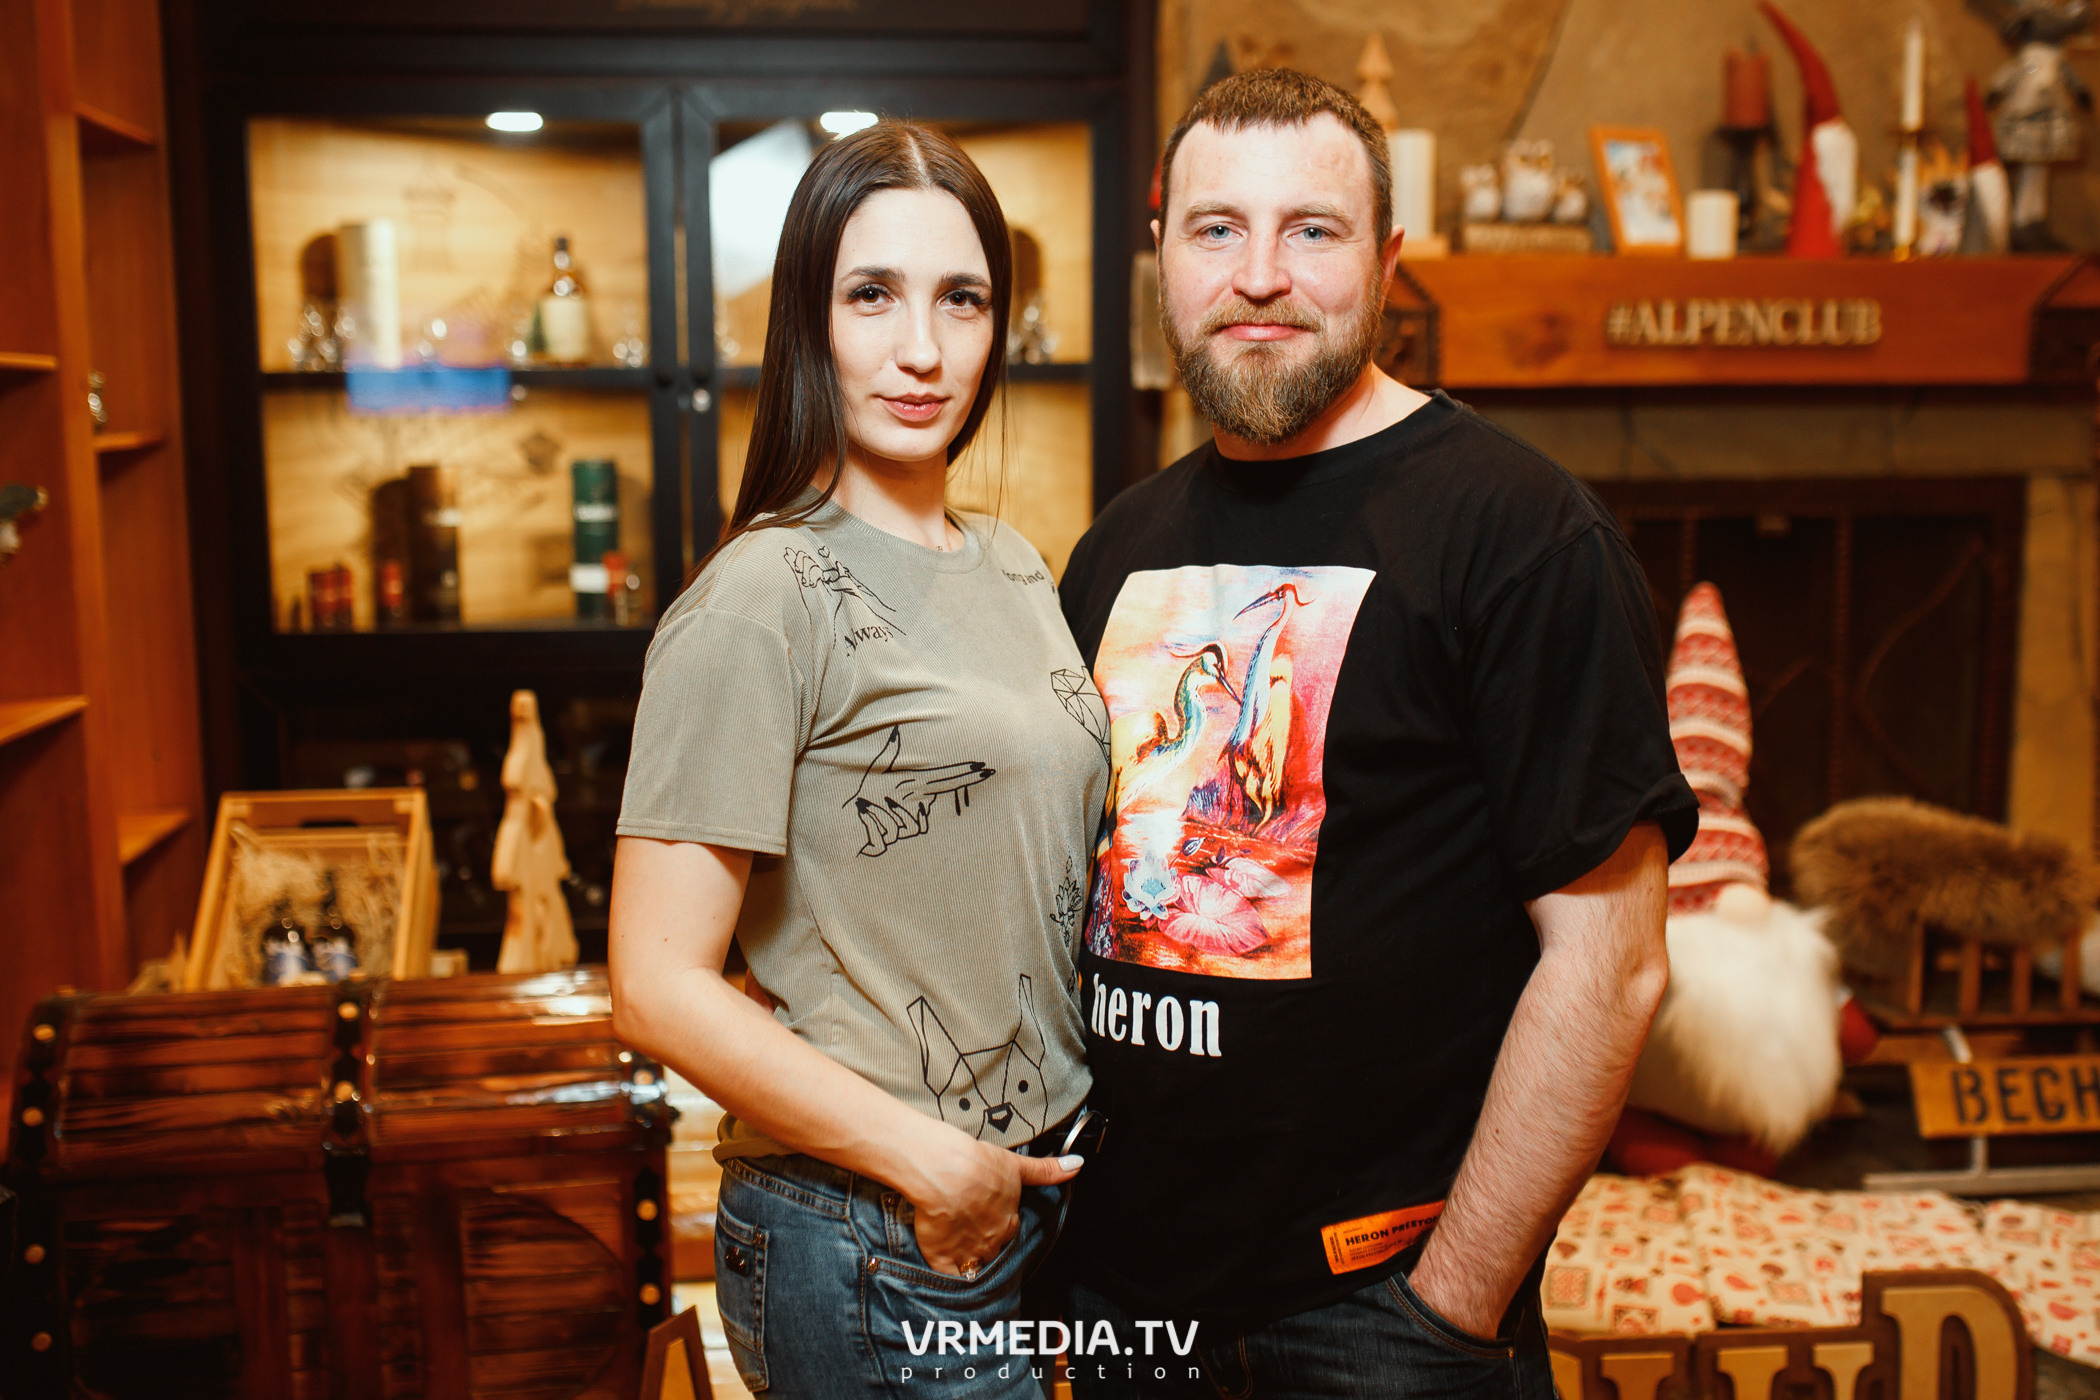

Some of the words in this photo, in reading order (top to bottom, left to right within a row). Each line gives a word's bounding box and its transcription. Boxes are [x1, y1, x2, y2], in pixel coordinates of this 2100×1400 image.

[1607, 299, 1883, 344] #ALPENCLUB
[1092, 973, 1222, 1057] heron
[1345, 1229, 1389, 1246] HERON
